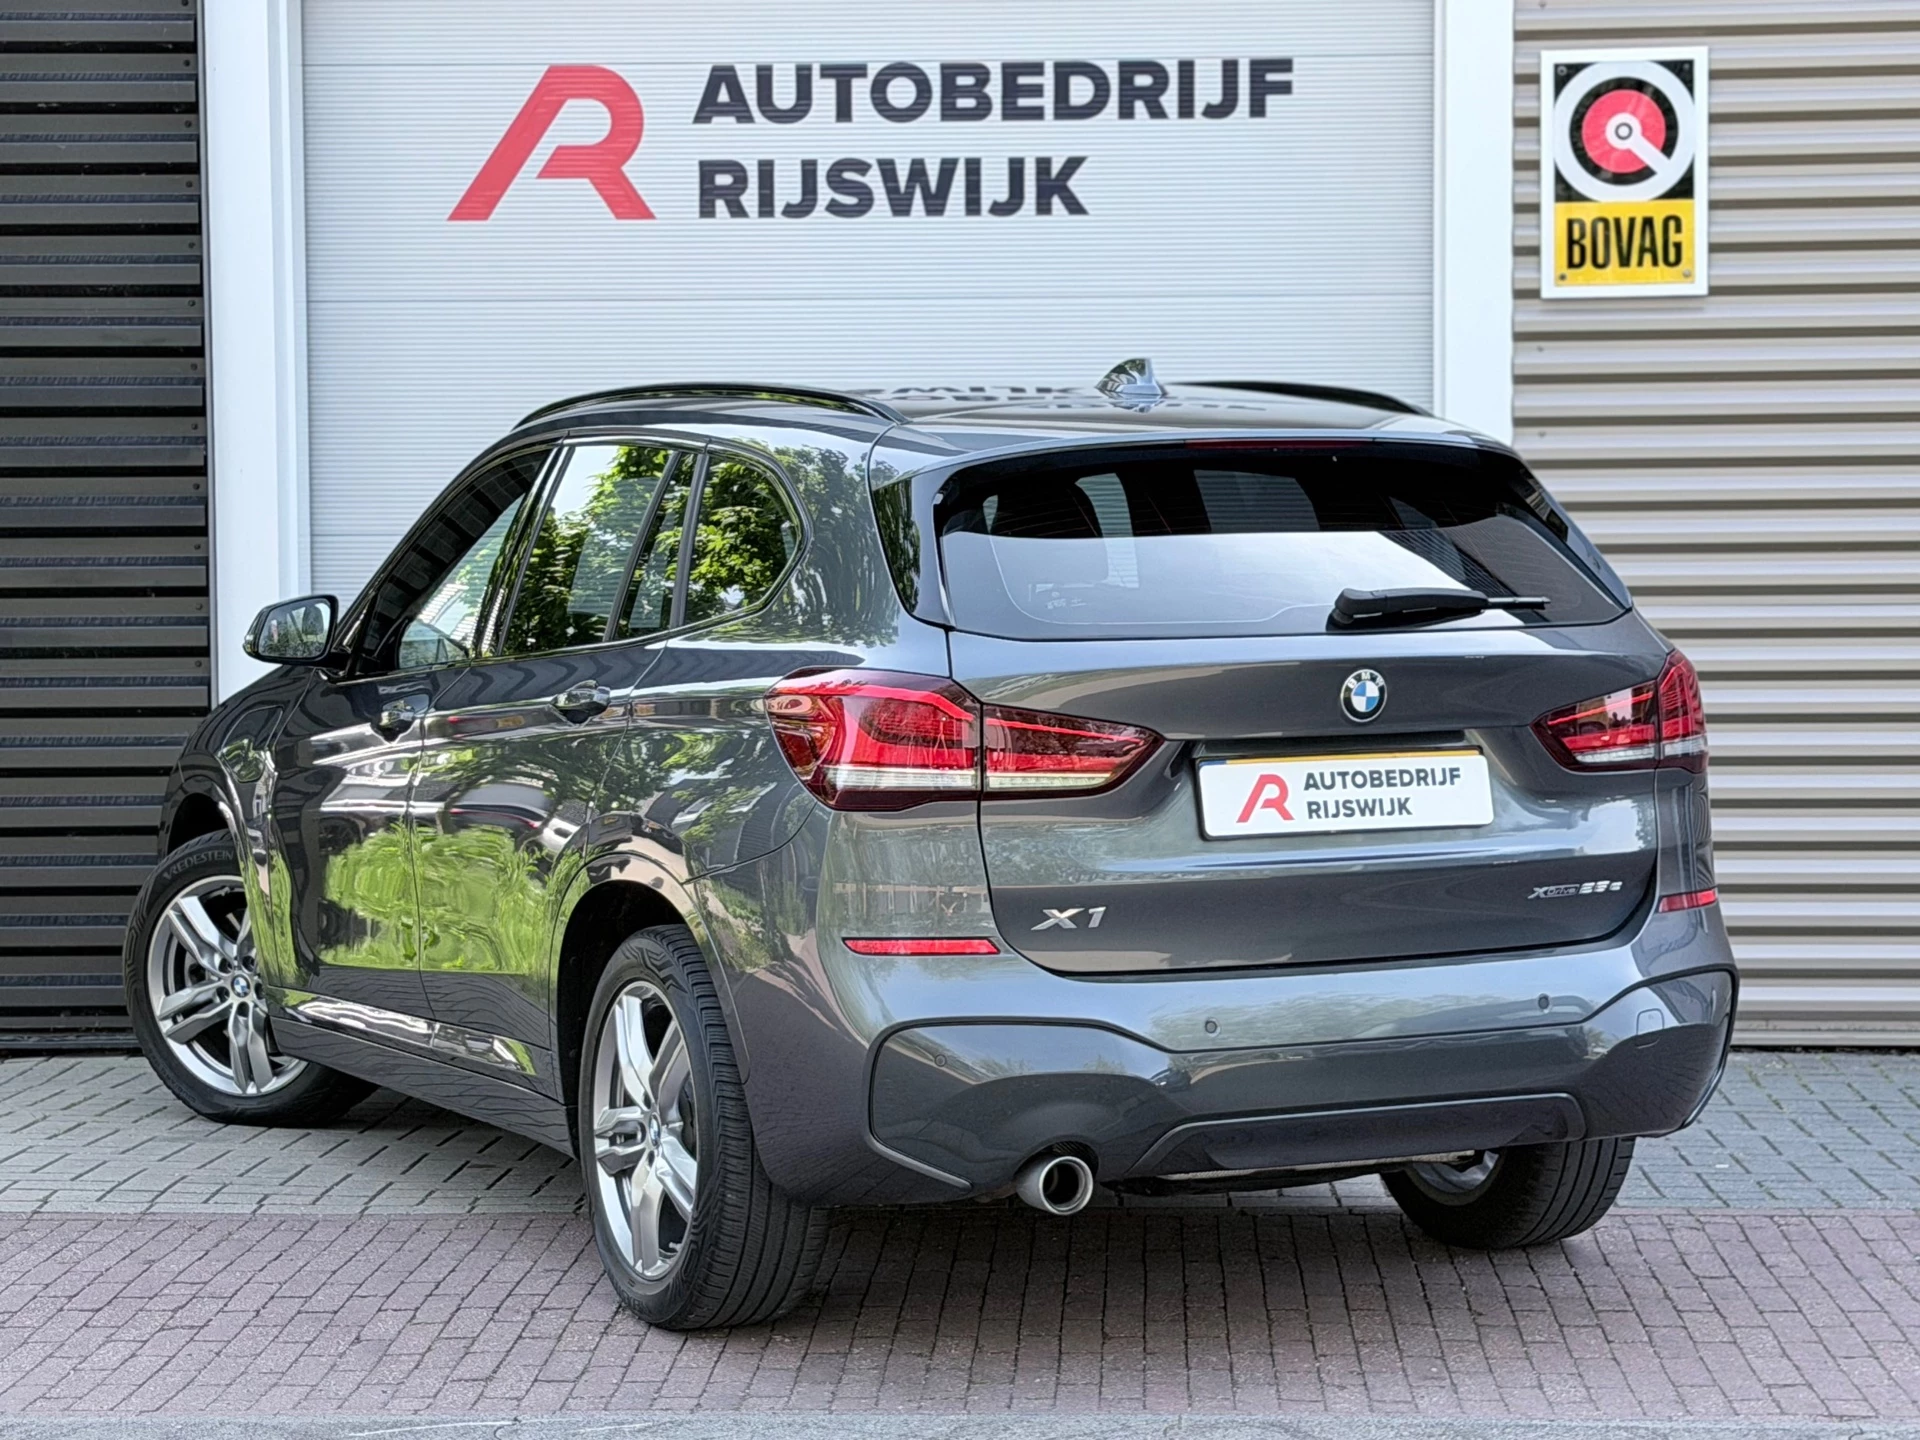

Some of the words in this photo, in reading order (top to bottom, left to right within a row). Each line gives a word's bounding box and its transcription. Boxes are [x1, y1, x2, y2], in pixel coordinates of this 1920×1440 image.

[692, 57, 1294, 125] AUTOBEDRIJF
[698, 156, 1089, 219] RIJSWIJK
[1566, 215, 1683, 270] BOVAG
[1303, 766, 1461, 791] AUTOBEDRIJF
[1306, 797, 1413, 820] RIJSWIJK
[1030, 906, 1107, 931] X1
